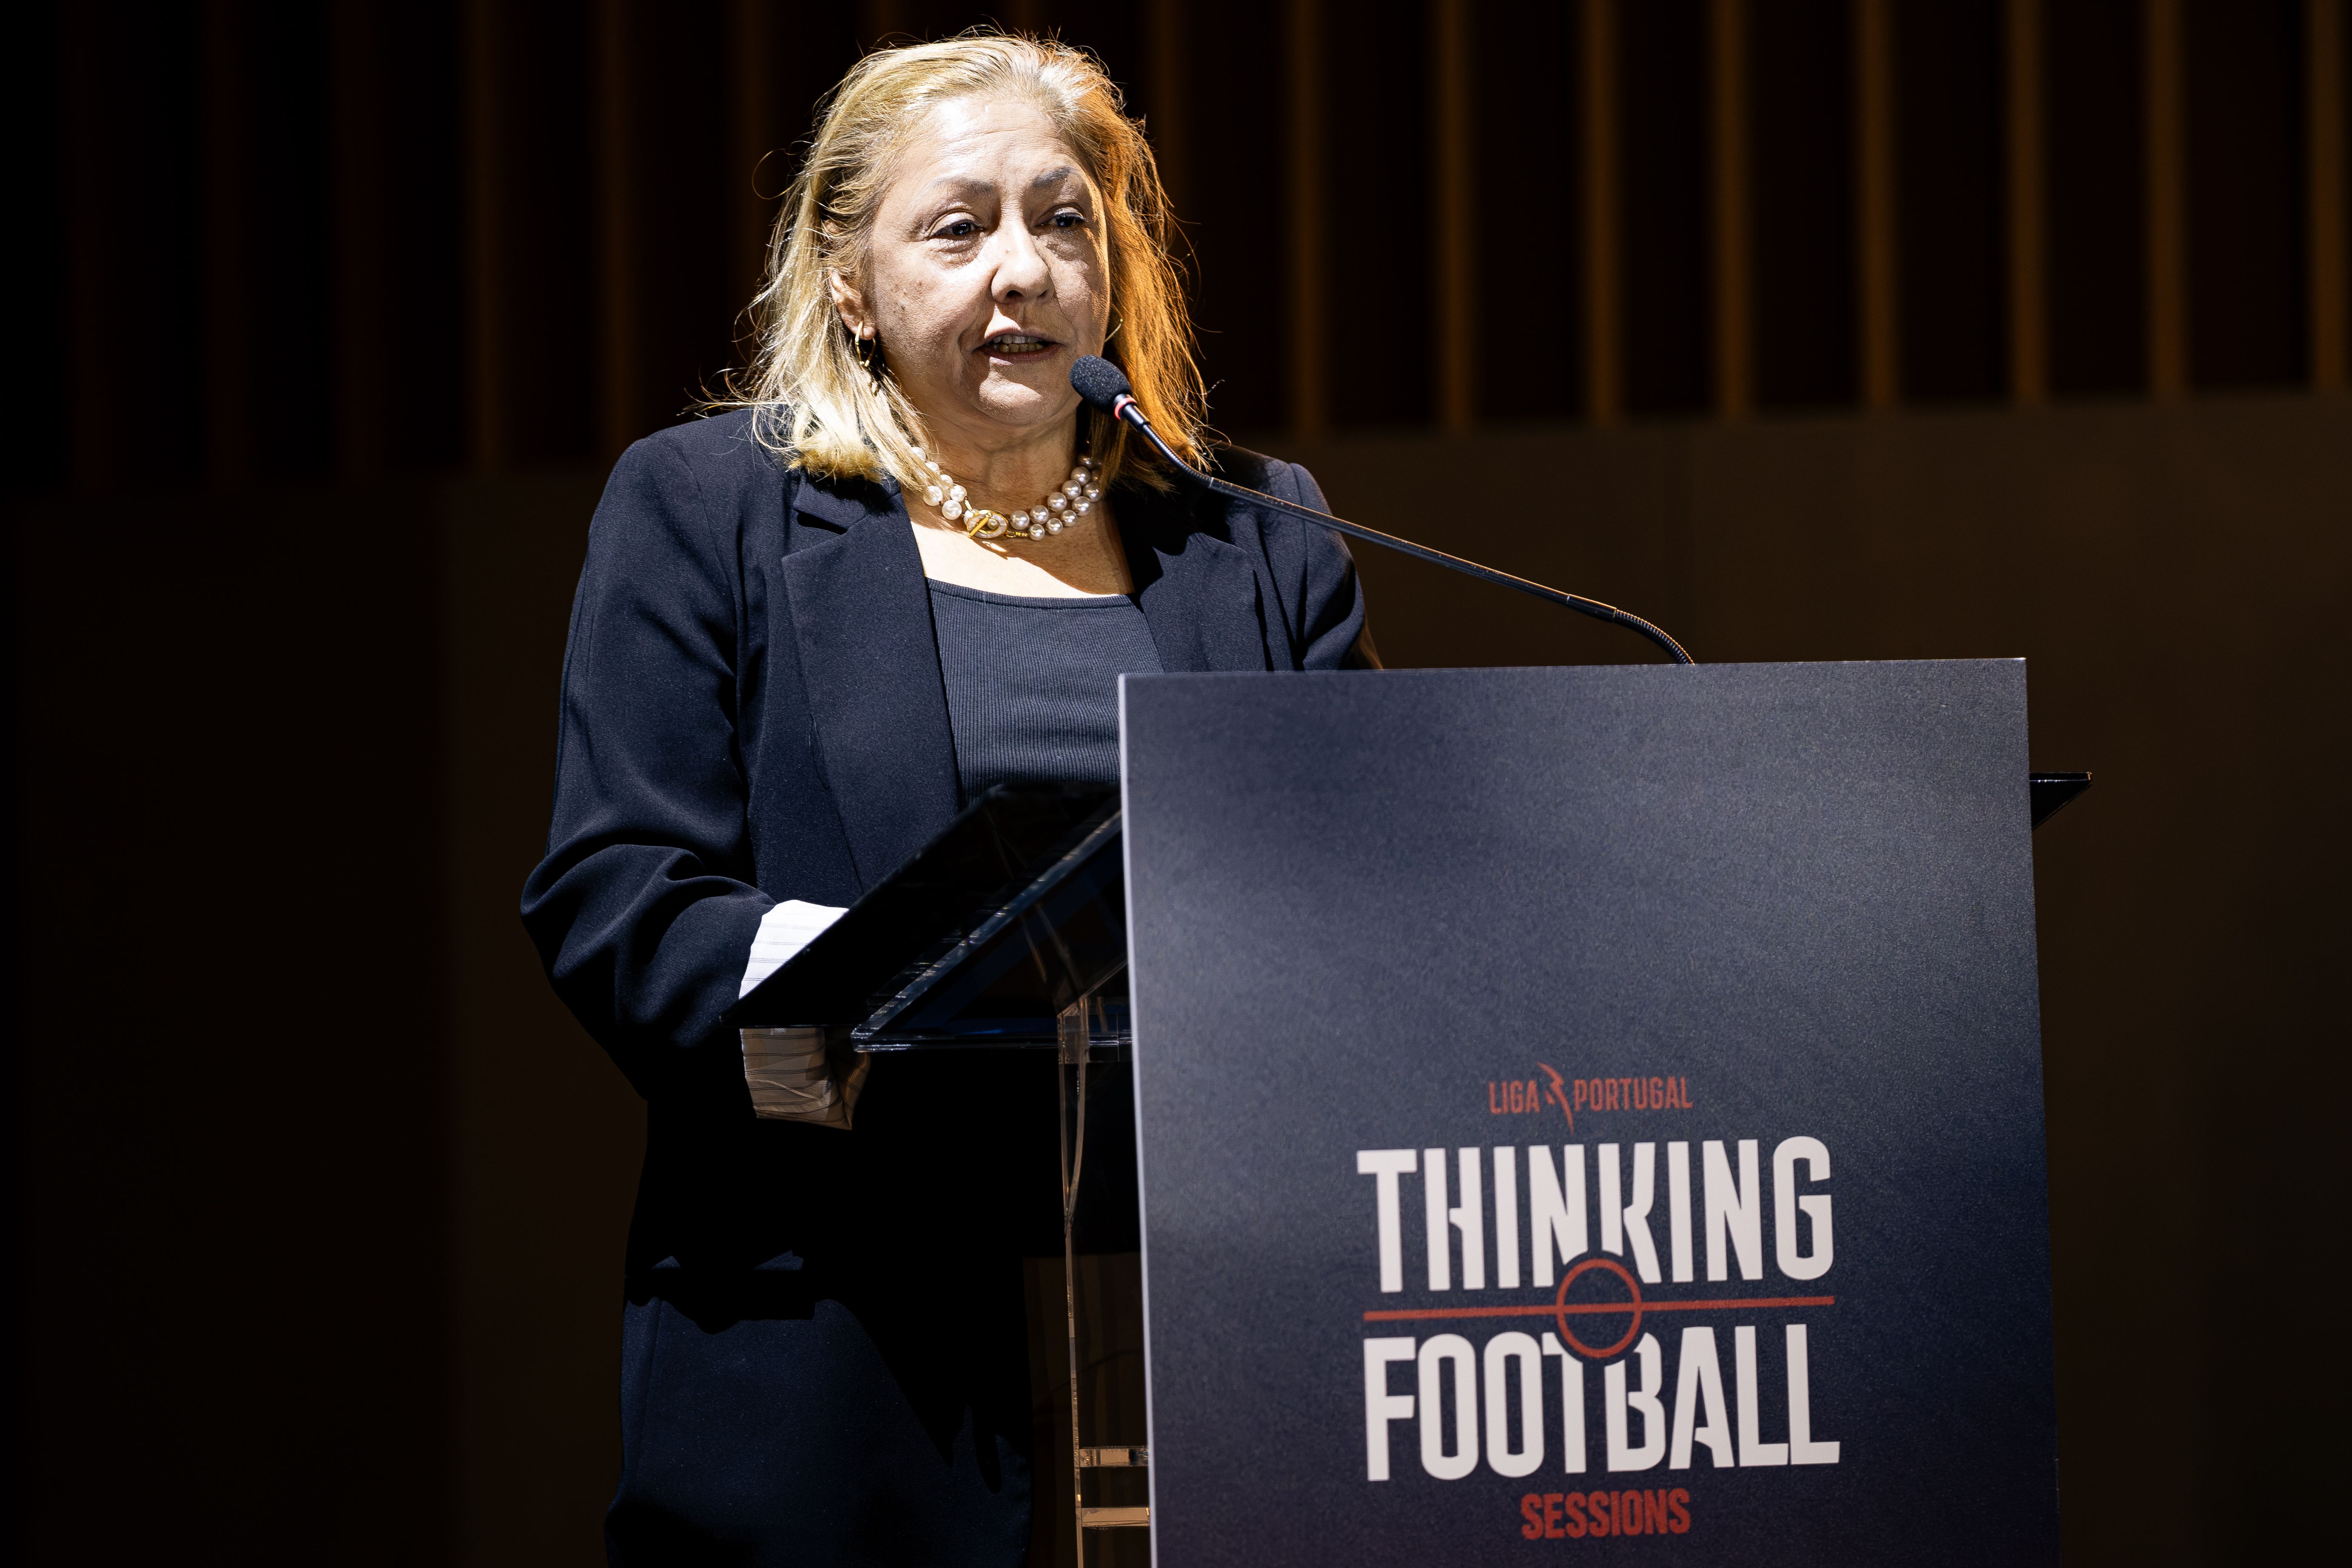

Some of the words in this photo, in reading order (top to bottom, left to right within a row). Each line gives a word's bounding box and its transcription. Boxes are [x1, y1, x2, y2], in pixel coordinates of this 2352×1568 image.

[1489, 1080, 1540, 1114] LIGA
[1574, 1076, 1693, 1112] PORTUGAL
[1357, 1136, 1833, 1292] THINKING
[1364, 1324, 1840, 1481] FOOTBALL
[1520, 1488, 1691, 1540] SESSIONS
